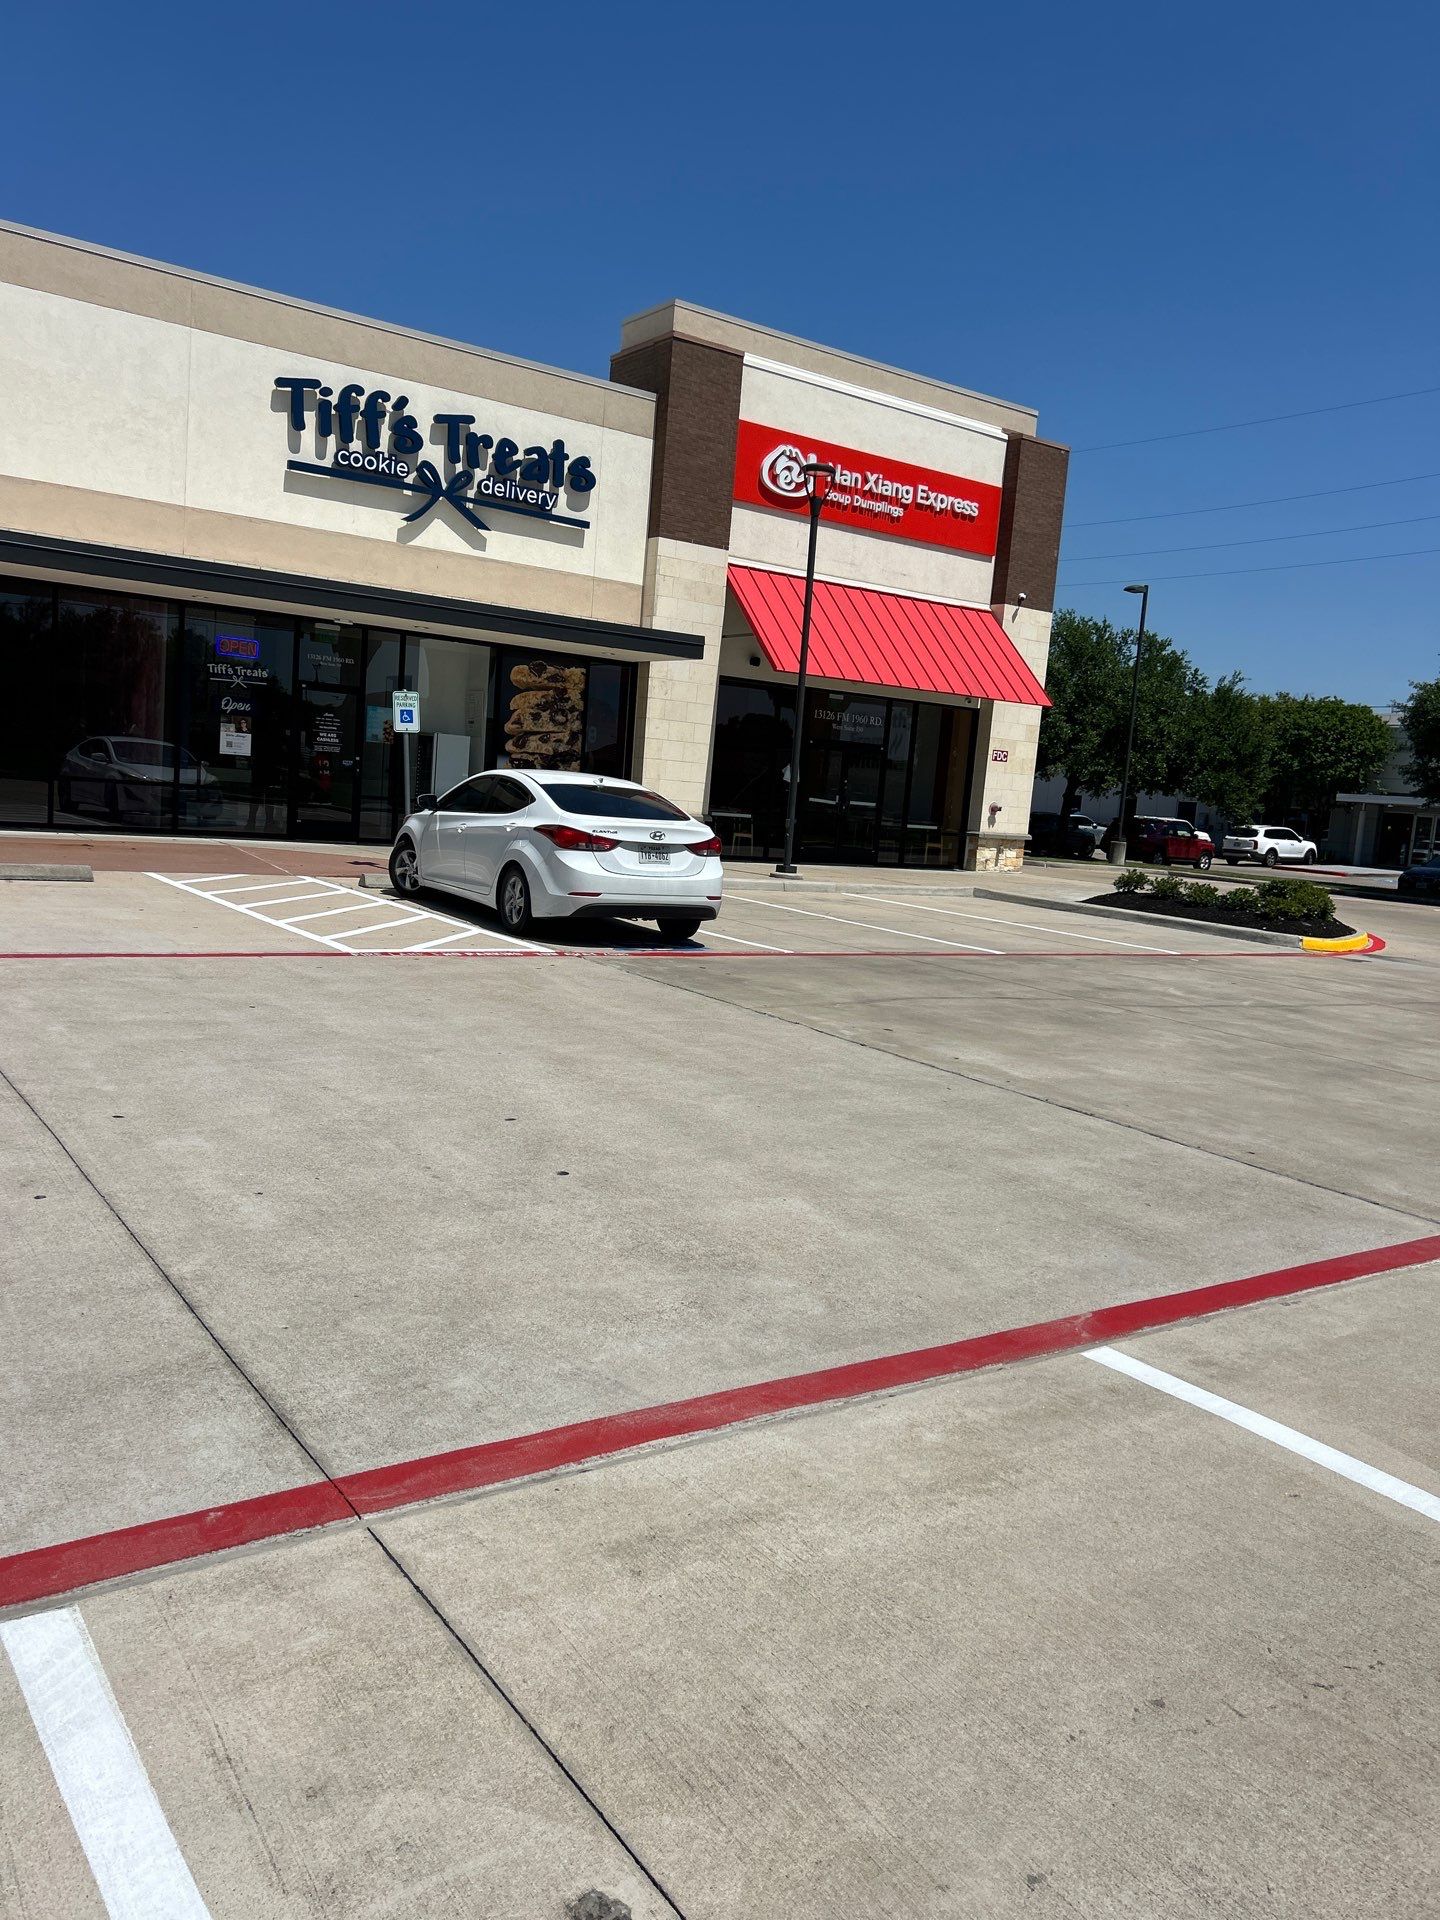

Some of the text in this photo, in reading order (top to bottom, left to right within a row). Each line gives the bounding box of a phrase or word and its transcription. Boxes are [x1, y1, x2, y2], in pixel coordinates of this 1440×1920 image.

[274, 377, 597, 492] Tiff's Treats
[337, 449, 558, 511] cookie delivery
[863, 471, 914, 504] Xiang
[917, 484, 979, 517] Express
[854, 495, 904, 517] Dumplings
[219, 639, 257, 657] OPEN
[207, 663, 269, 678] Tiff's Treats
[221, 697, 251, 714] Open
[814, 709, 835, 720] 13126
[837, 712, 850, 722] FM
[852, 714, 868, 724] 1960
[992, 750, 1008, 762] FDC
